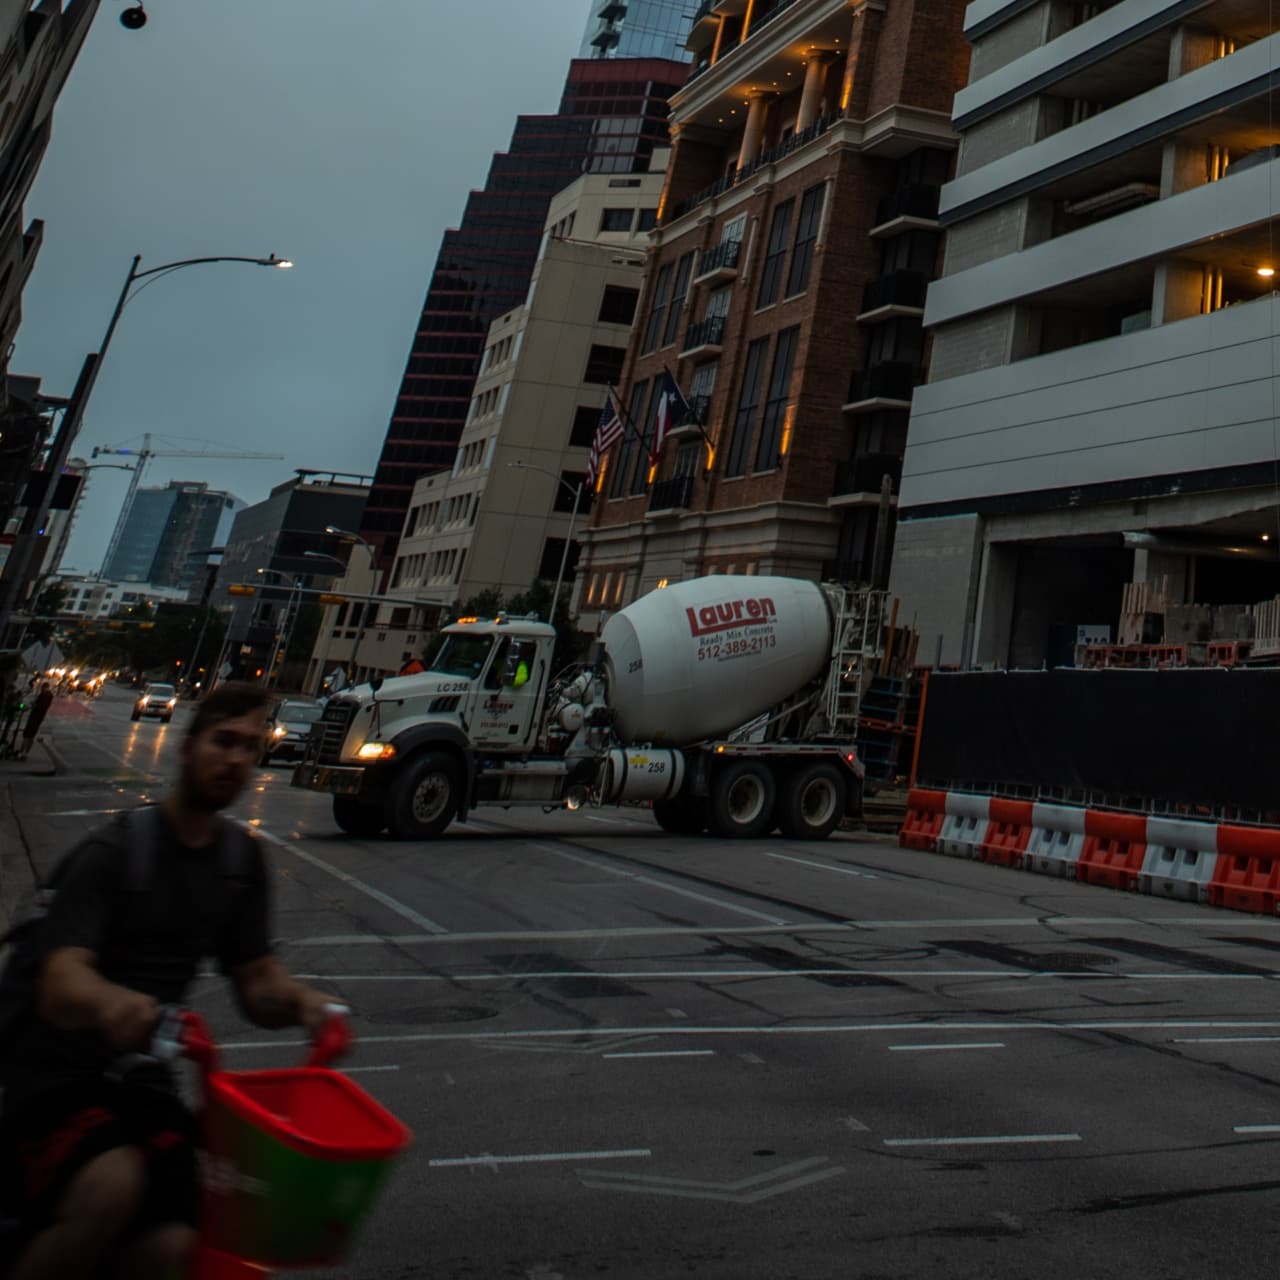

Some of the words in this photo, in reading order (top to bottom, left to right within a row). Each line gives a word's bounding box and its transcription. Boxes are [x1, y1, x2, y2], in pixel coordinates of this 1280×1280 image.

[686, 598, 776, 638] Lauren
[698, 635, 776, 661] 512-389-2113
[648, 761, 665, 773] 258
